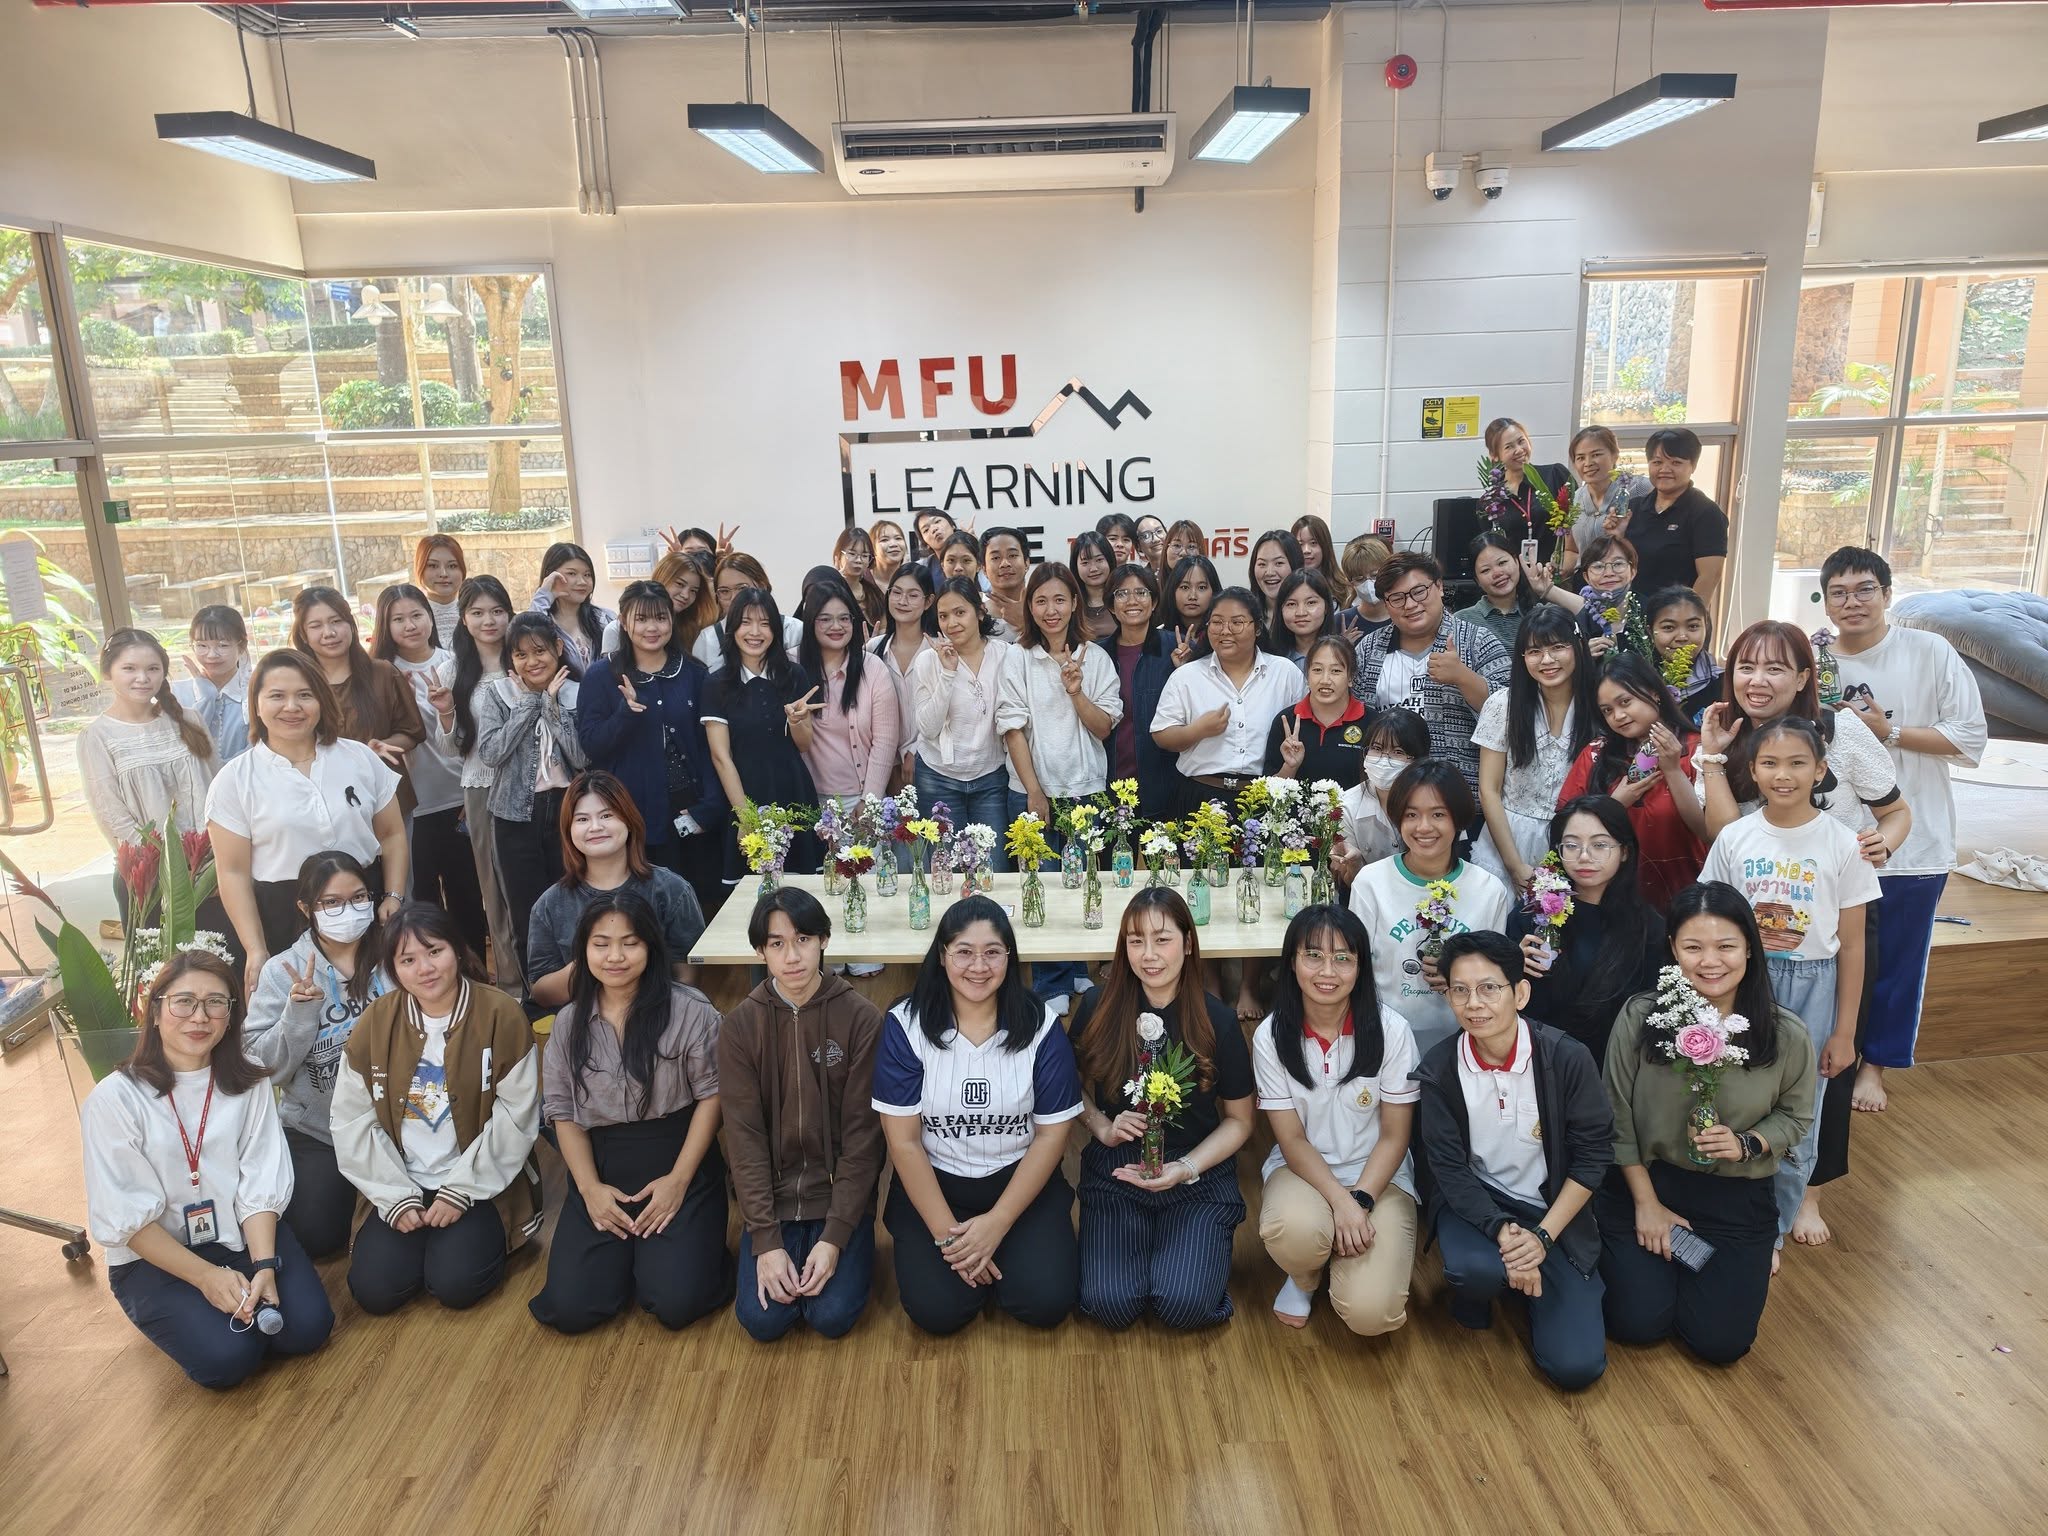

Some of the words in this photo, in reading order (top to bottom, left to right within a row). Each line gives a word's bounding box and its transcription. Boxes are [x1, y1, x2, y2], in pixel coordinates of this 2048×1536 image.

[839, 354, 1017, 421] MFU
[869, 456, 1155, 514] LEARNING
[945, 1114, 983, 1126] FAH
